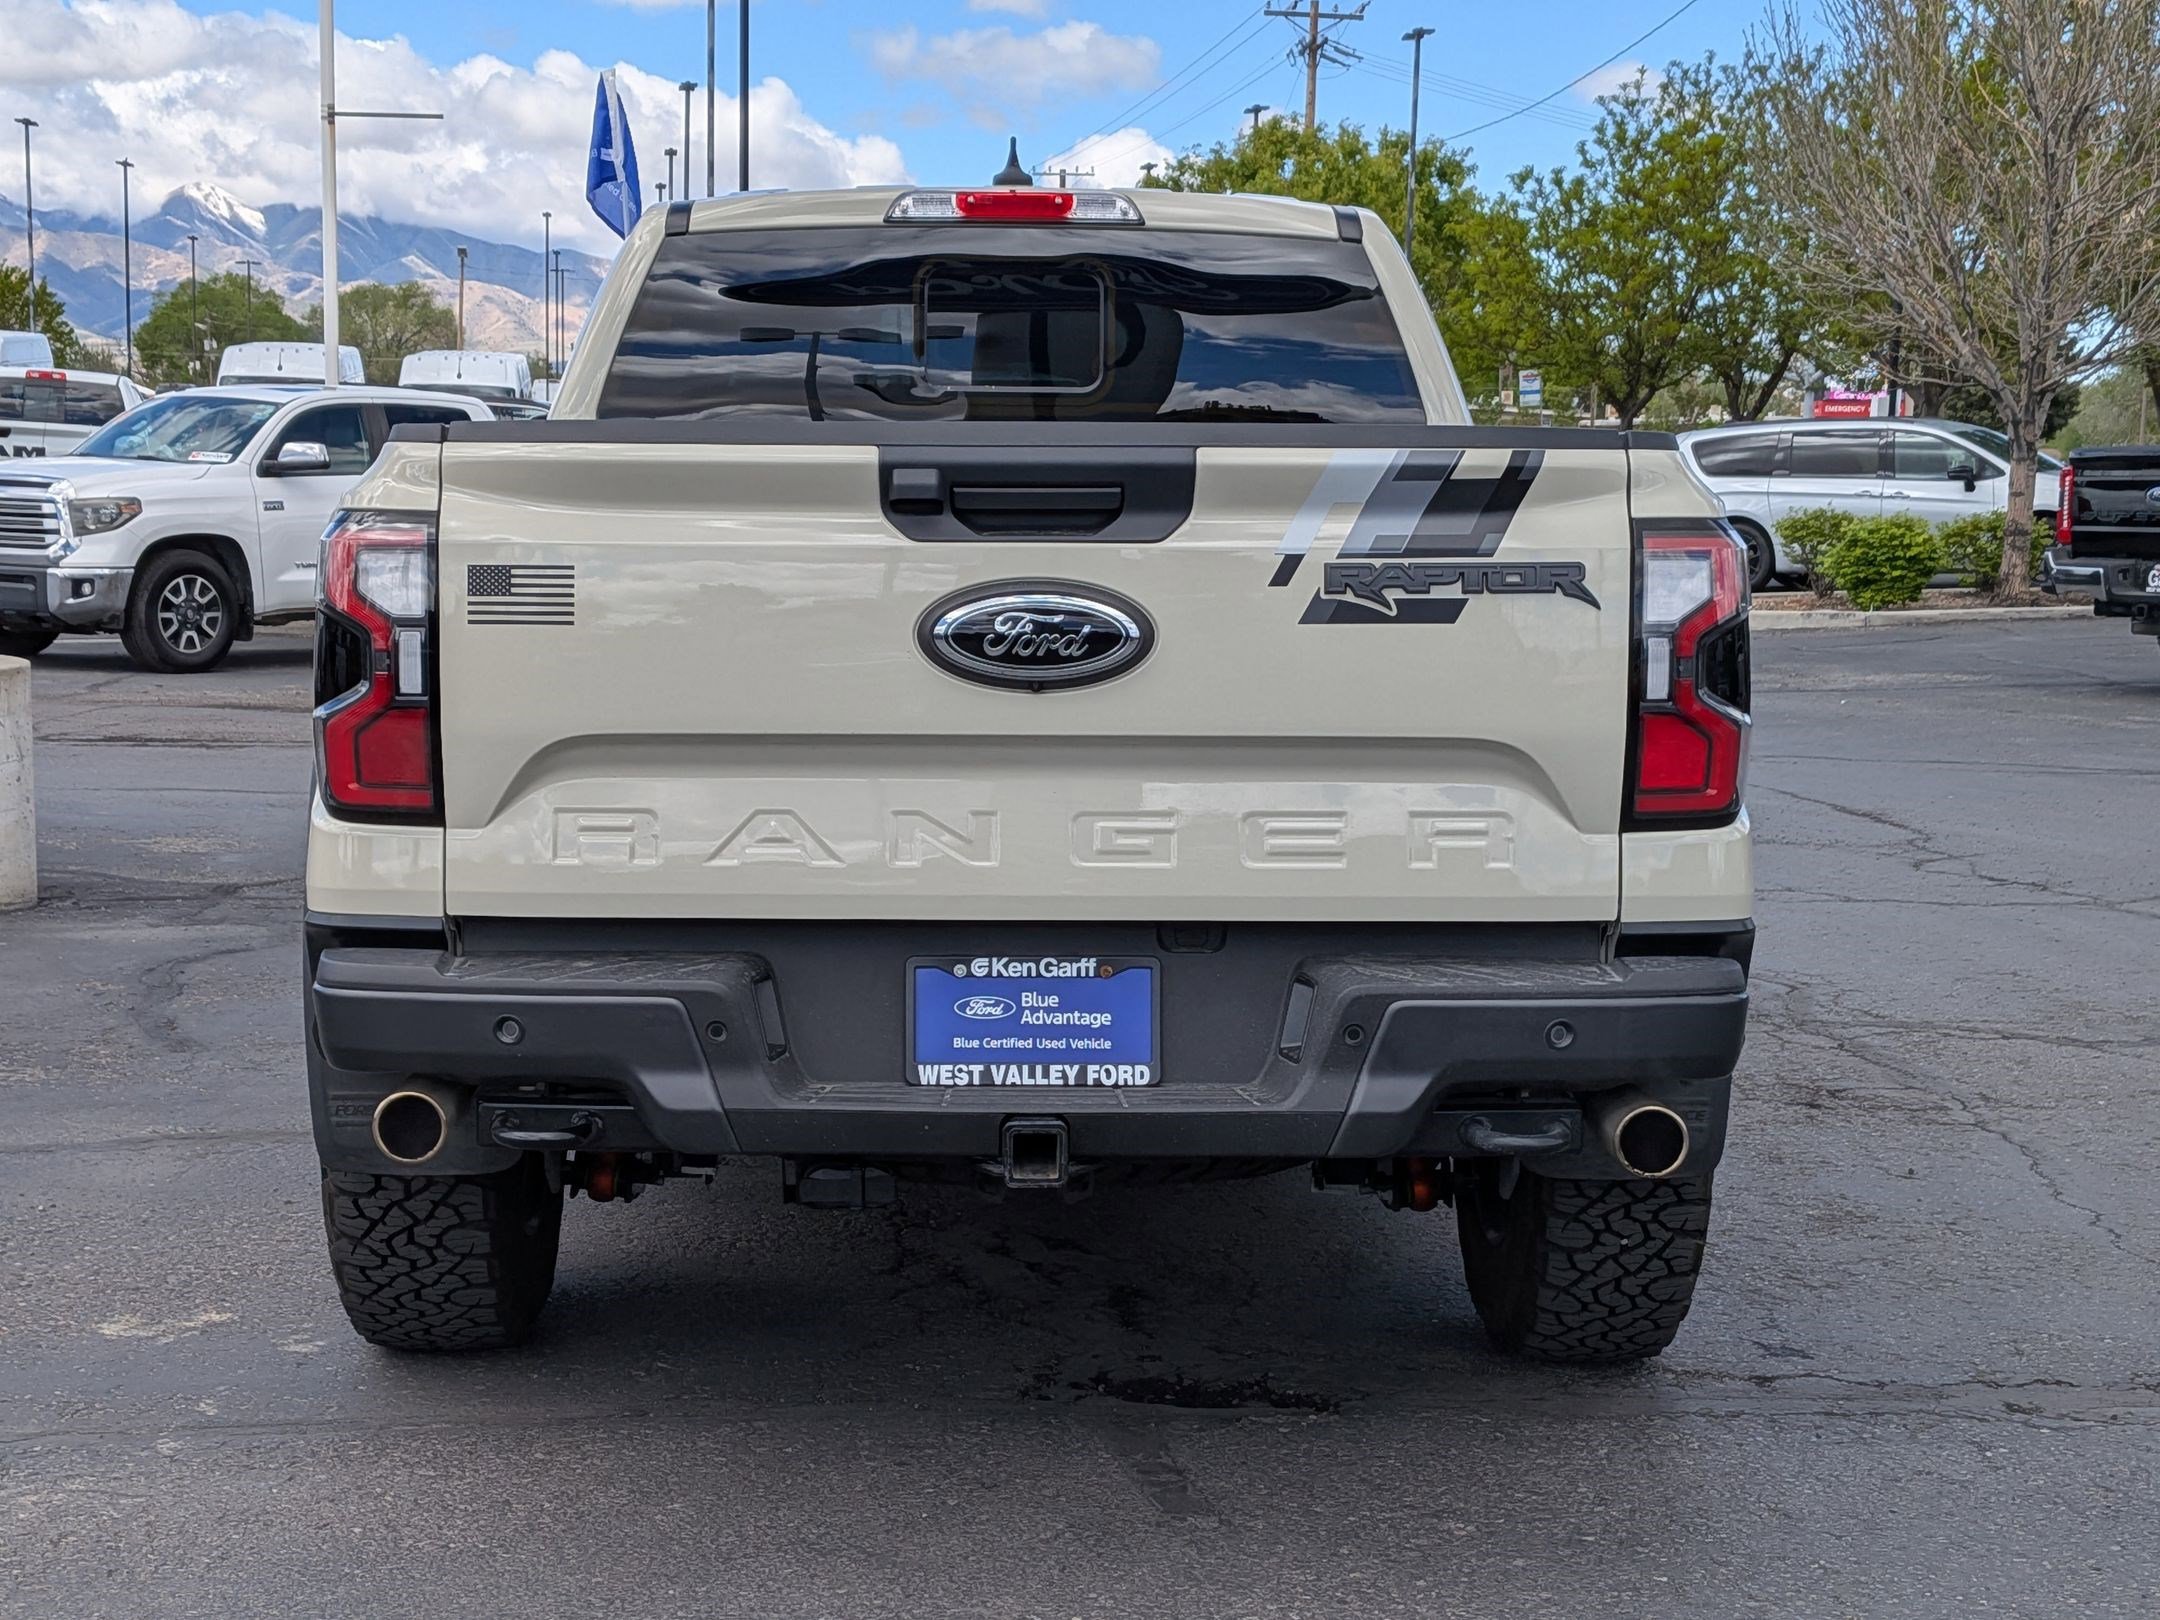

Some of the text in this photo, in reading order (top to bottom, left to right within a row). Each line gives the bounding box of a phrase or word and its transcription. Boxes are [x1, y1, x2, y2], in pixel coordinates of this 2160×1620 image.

[1824, 404, 1866, 412] EMERGENCY
[0, 444, 46, 457] AM
[1323, 561, 1602, 612] RAPTOR
[982, 611, 1092, 657] Ford
[551, 806, 1516, 869] RANGER
[992, 957, 1036, 977] Ken
[1039, 957, 1096, 978] Garff
[965, 998, 1005, 1016] Ford
[1021, 991, 1059, 1008] Blue
[1020, 1009, 1112, 1028] Advantage
[953, 1037, 1112, 1050] Blue Certified Used Vehicle
[917, 1064, 1151, 1086] WEST VALLEY FORD
